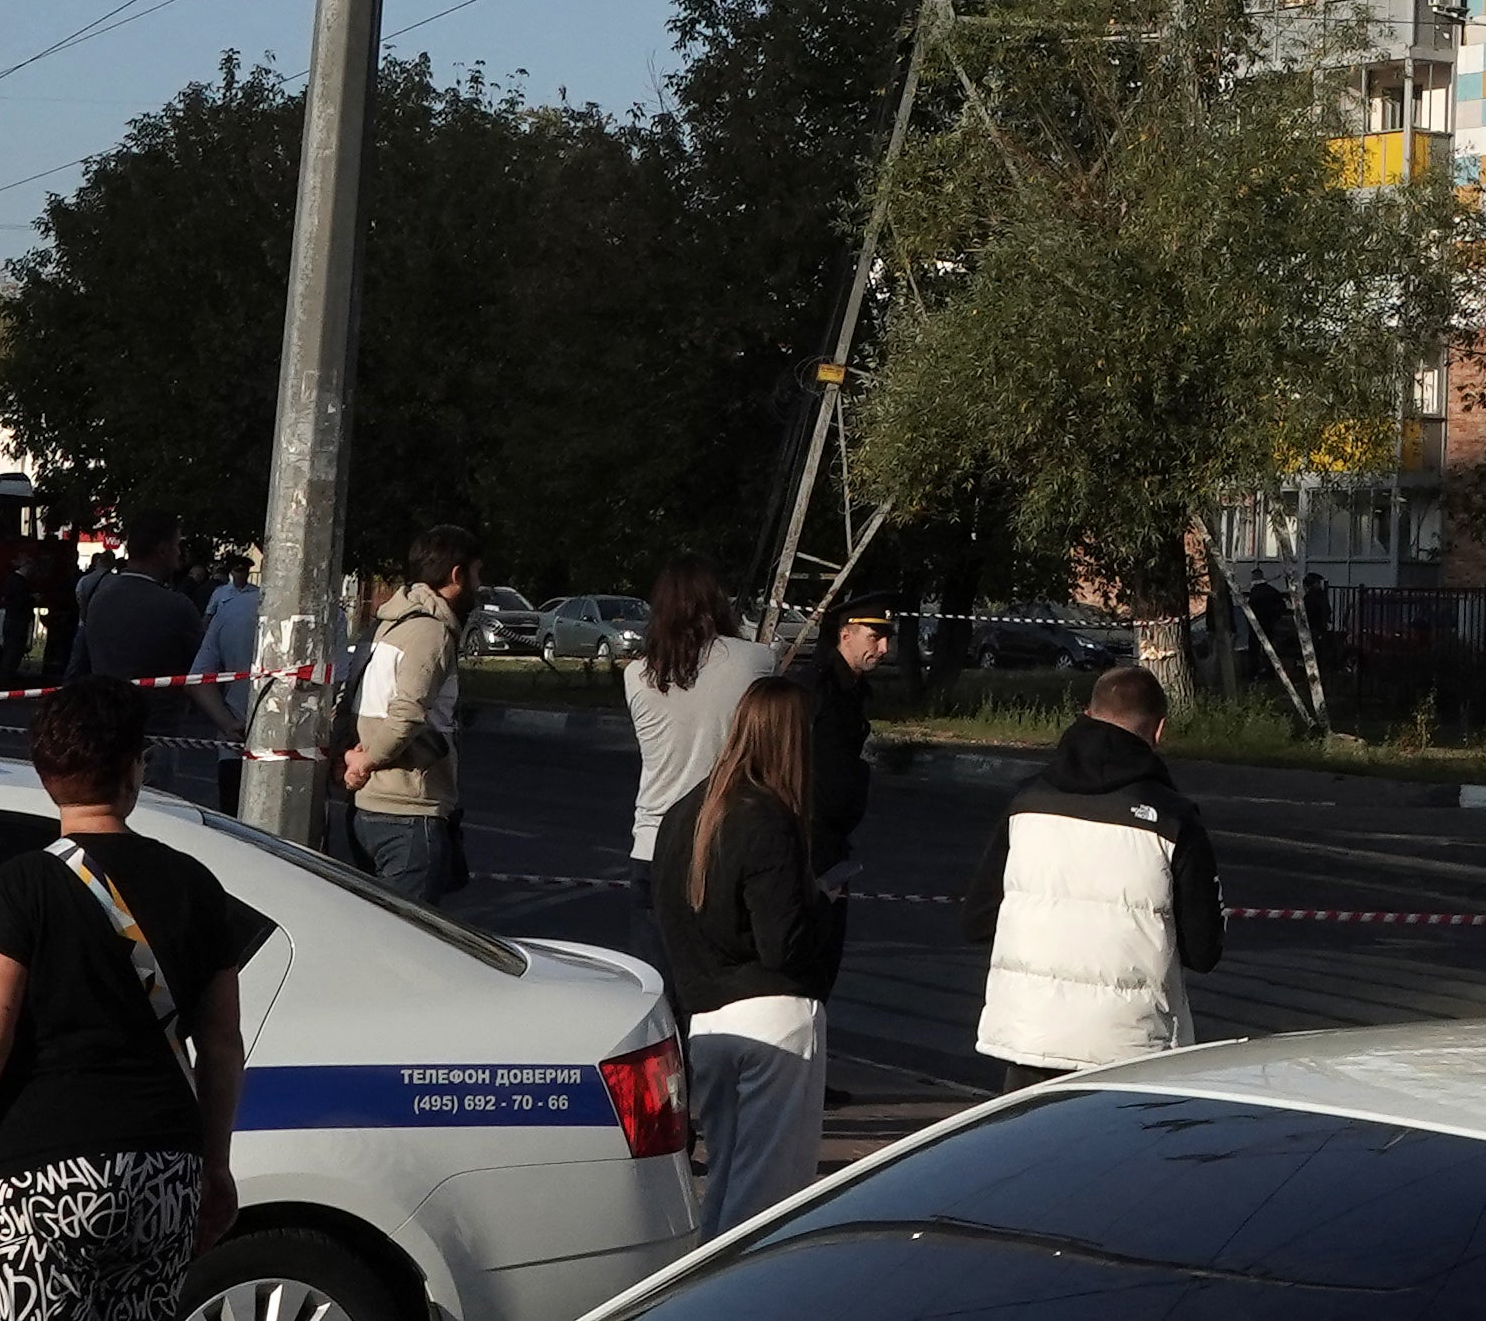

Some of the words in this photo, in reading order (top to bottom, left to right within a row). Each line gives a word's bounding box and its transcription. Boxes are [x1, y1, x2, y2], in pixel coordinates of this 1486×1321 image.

[400, 1068, 490, 1085] ТЕЛЕФОН
[495, 1069, 581, 1087] ДОВЕРИЯ
[413, 1094, 458, 1114] (495)
[464, 1094, 496, 1111] 692
[512, 1094, 533, 1111] 70
[547, 1094, 569, 1110] 66
